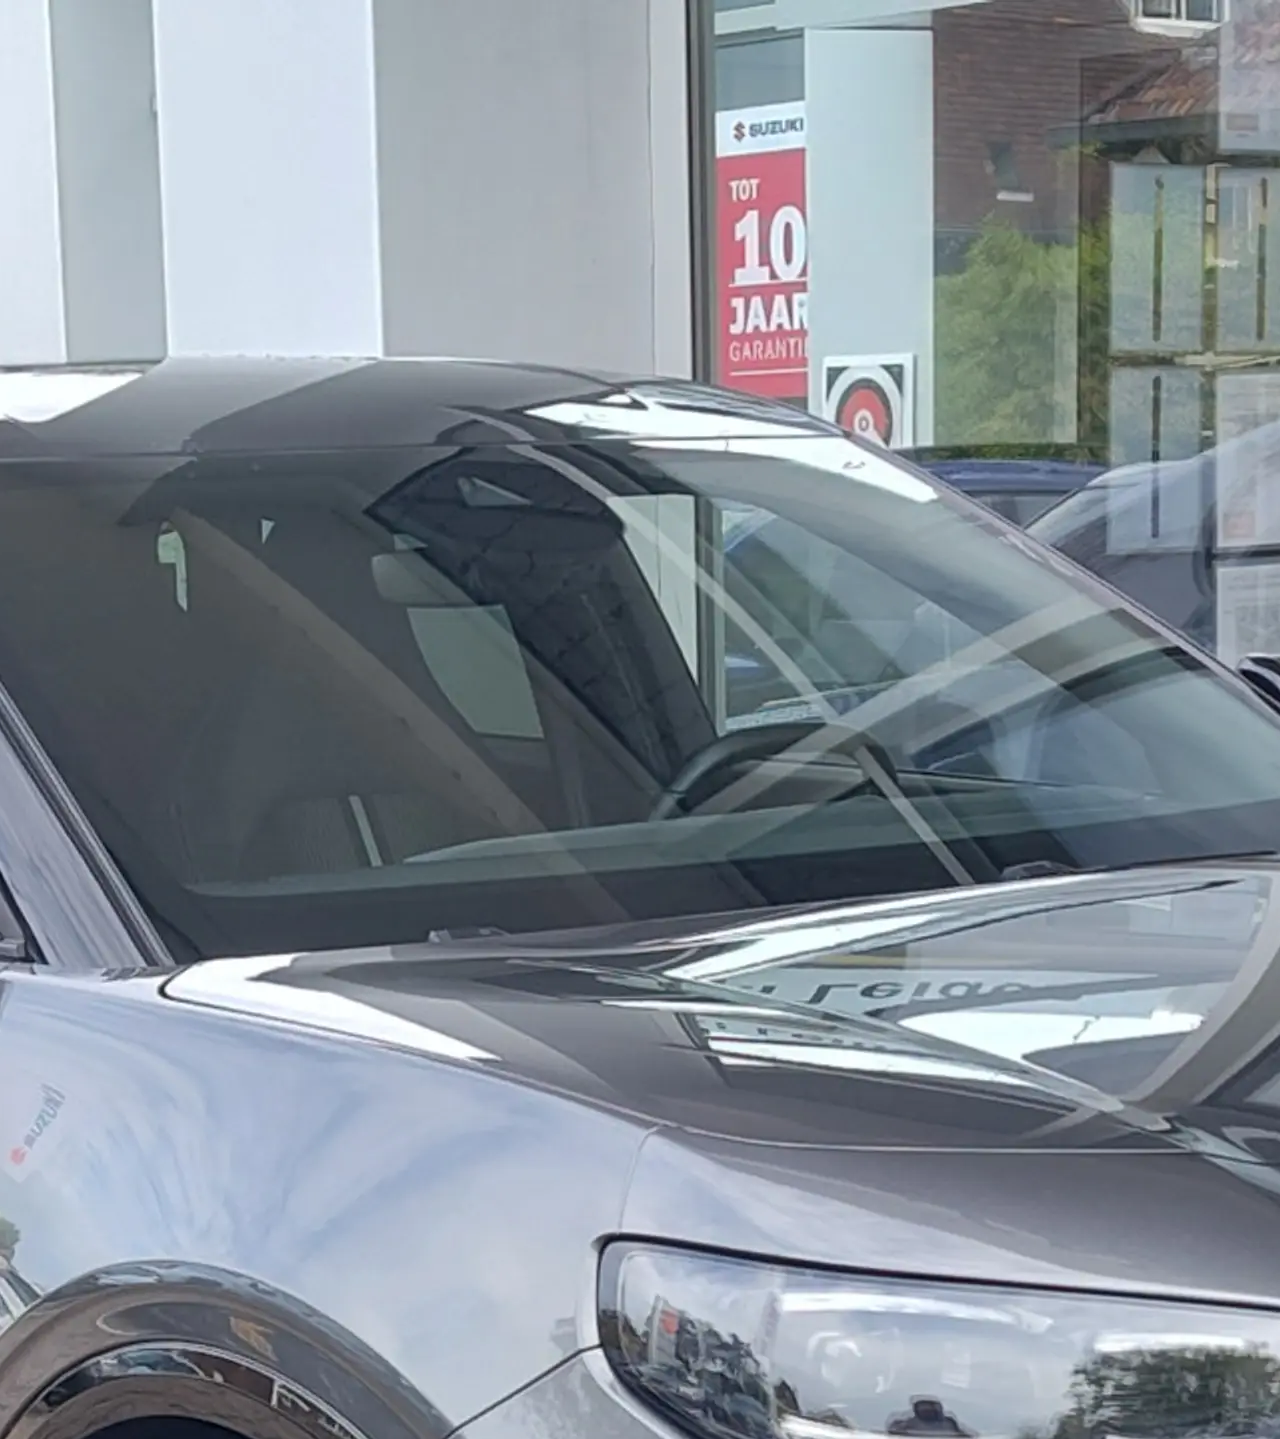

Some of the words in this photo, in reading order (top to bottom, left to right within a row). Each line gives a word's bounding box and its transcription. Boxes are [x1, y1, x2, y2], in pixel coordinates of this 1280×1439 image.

[749, 117, 804, 138] SUZUKI
[728, 177, 761, 203] TOT
[733, 205, 806, 285] 10
[729, 293, 809, 335] JAAR
